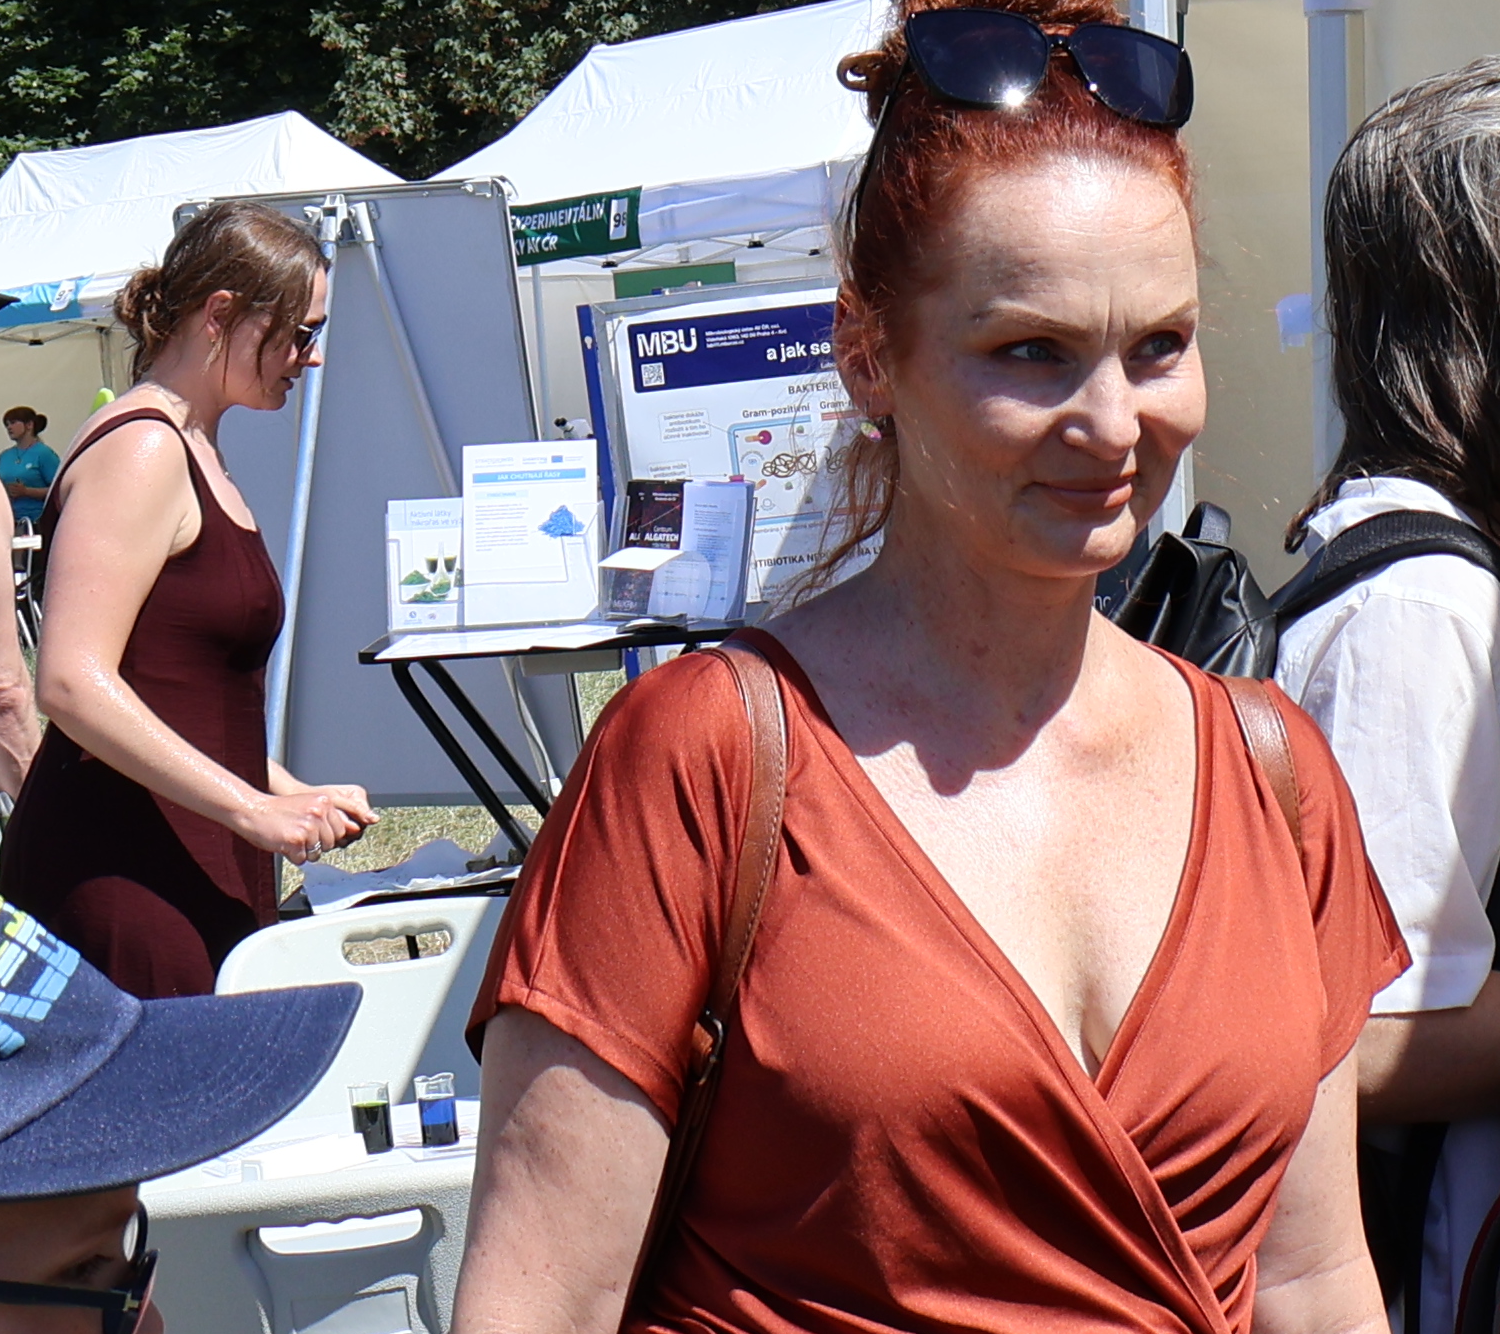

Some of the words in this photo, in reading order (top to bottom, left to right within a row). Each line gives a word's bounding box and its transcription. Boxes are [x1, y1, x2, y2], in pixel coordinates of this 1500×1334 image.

[541, 233, 558, 251] ČR
[637, 327, 698, 357] MBU
[766, 347, 777, 360] a
[780, 341, 806, 362] jak
[810, 341, 831, 354] se
[788, 381, 839, 395] BAKTERIE
[644, 532, 679, 541] ALGATECH
